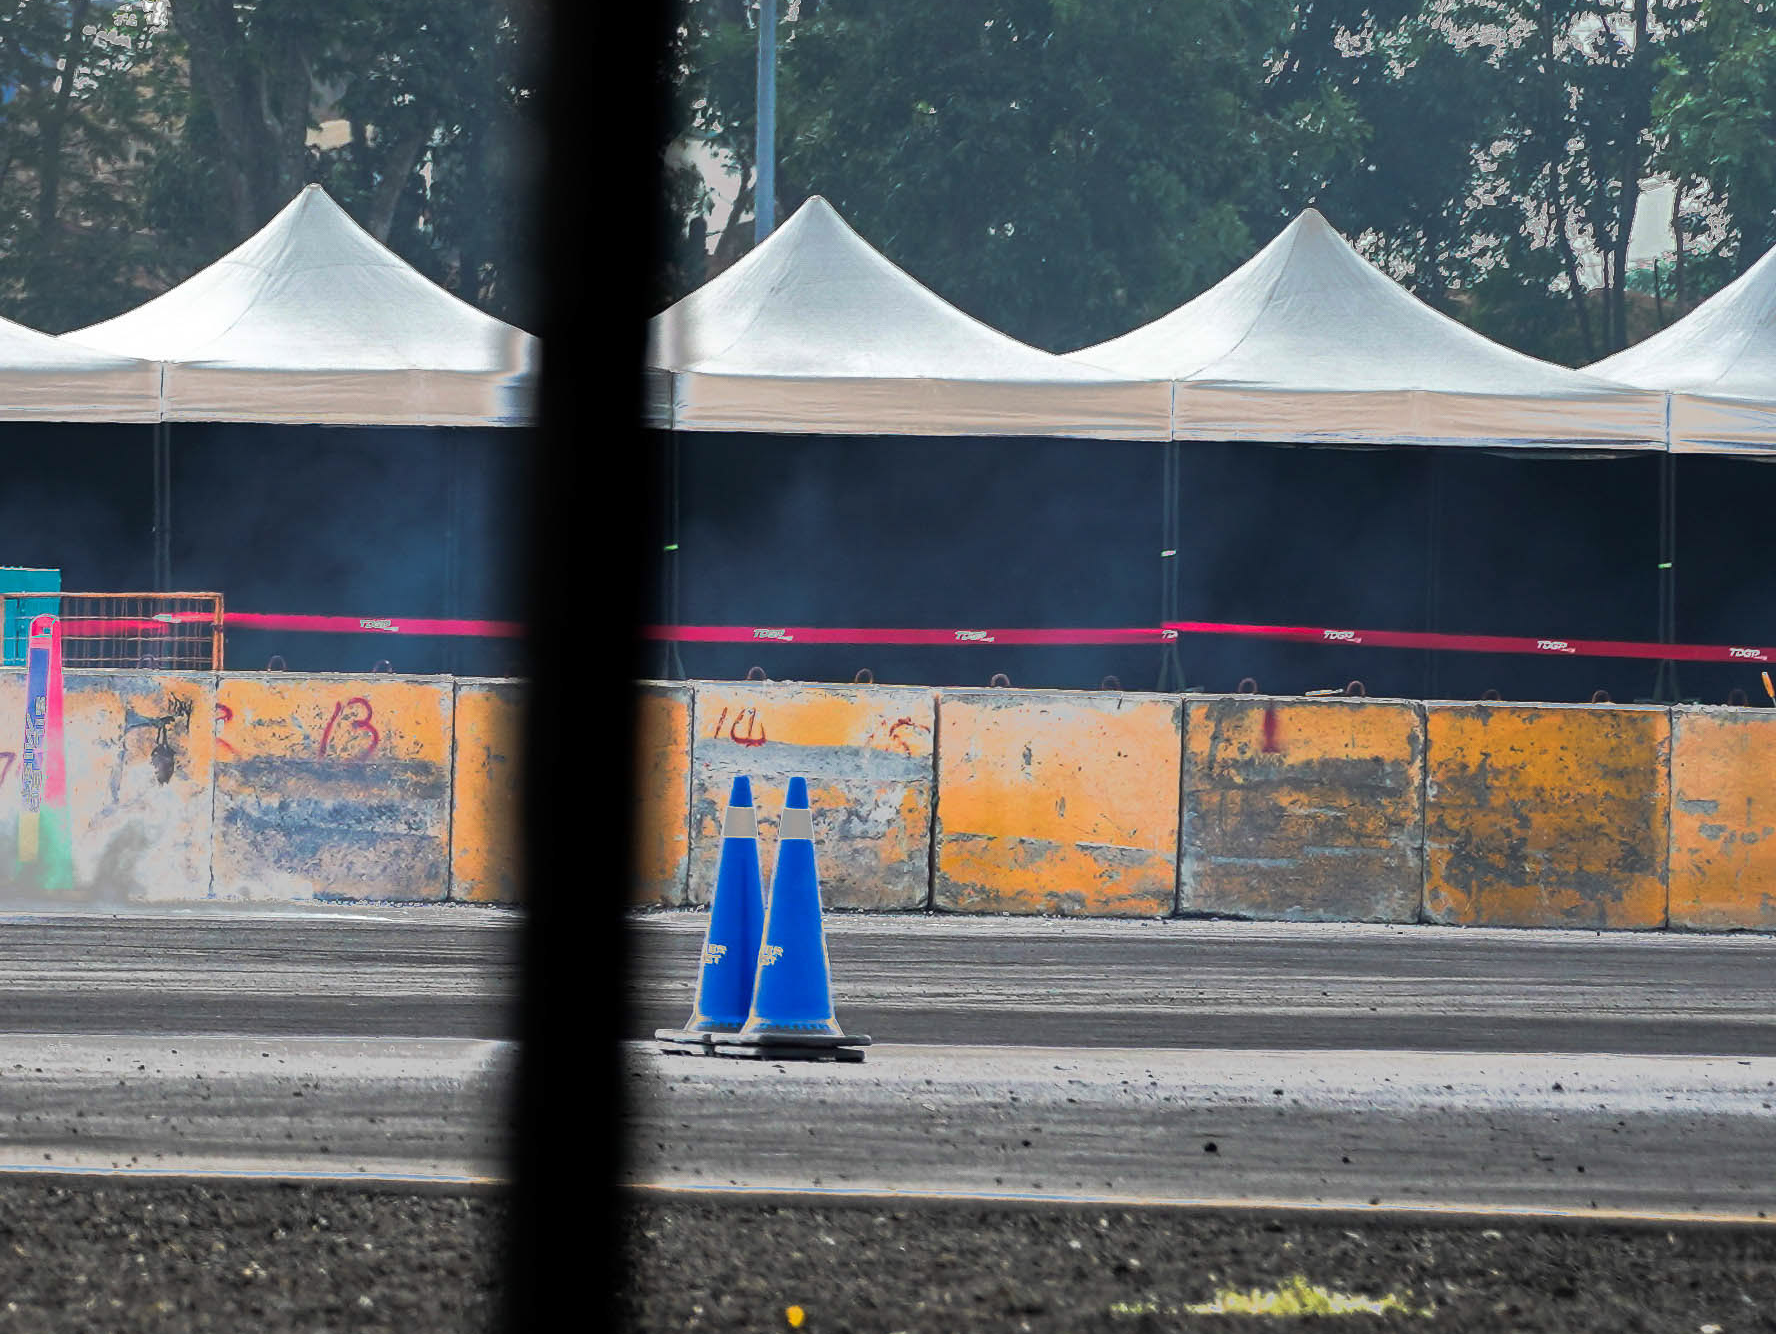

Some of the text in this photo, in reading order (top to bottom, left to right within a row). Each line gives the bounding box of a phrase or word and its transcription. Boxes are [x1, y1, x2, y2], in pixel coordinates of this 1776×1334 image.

[1322, 630, 1355, 640] TDGP
[1537, 640, 1569, 650] TDGP
[1729, 647, 1761, 659] TDGP
